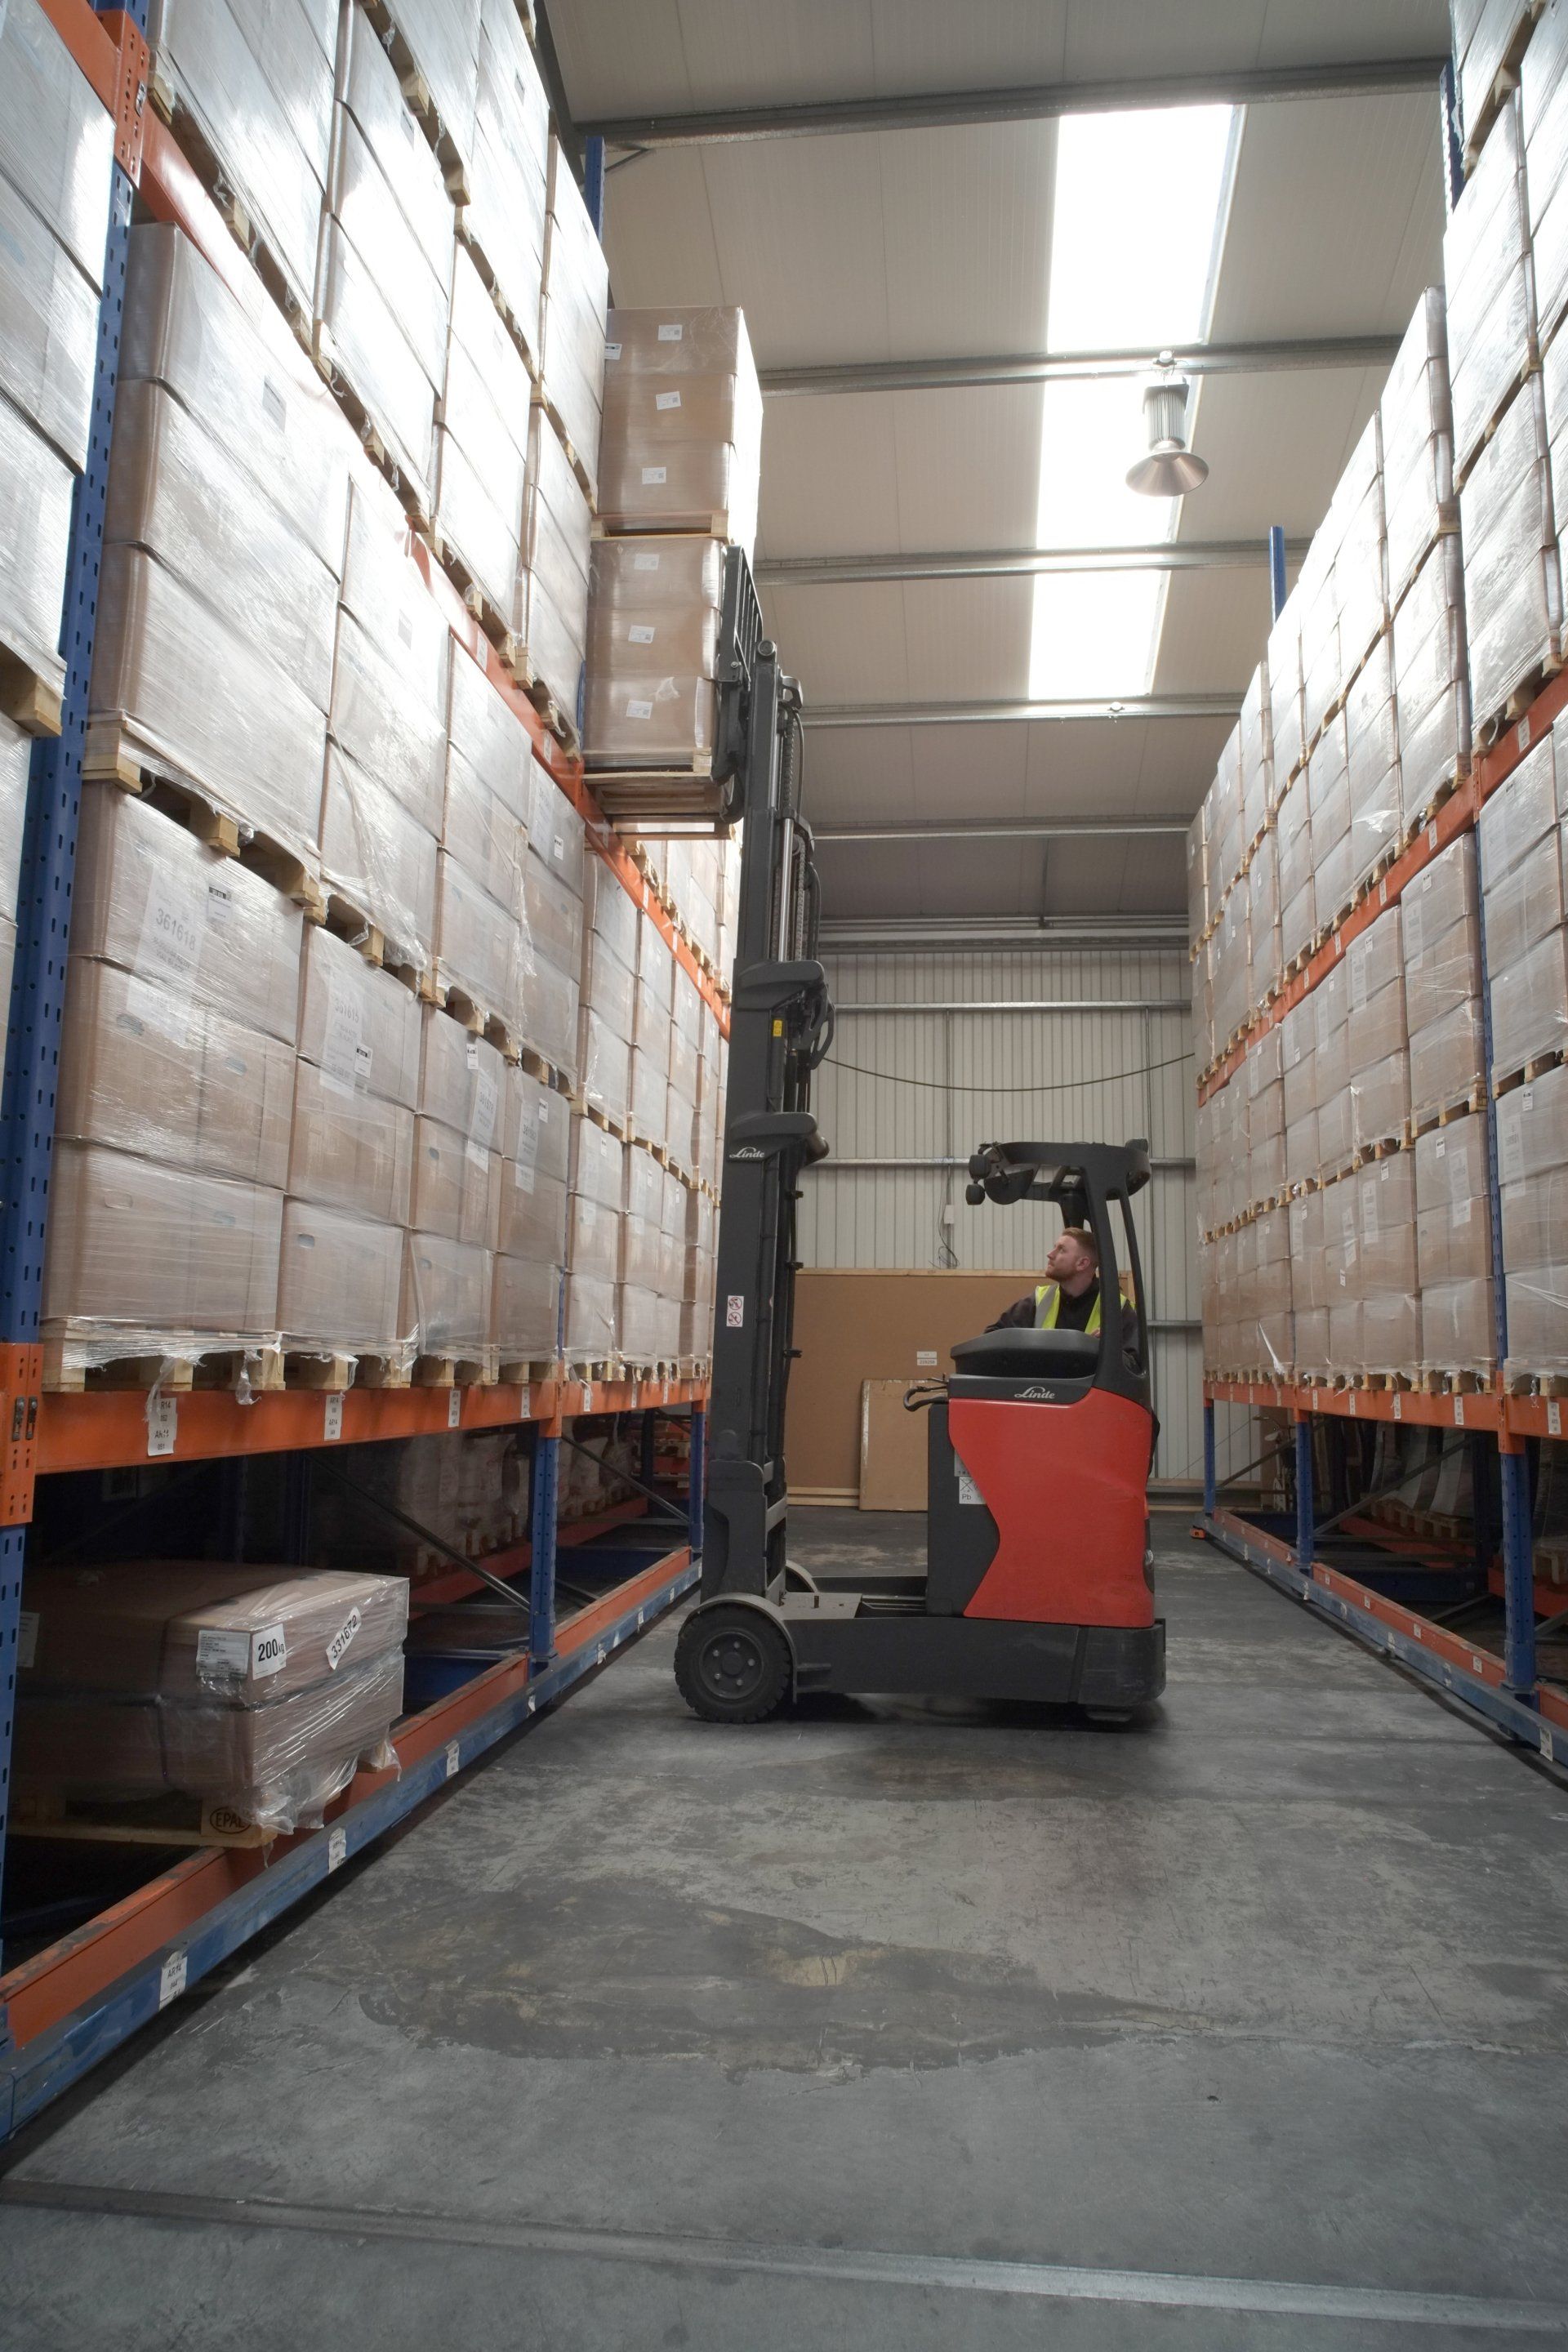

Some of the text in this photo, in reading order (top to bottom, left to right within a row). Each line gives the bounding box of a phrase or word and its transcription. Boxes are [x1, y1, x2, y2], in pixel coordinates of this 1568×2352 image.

[156, 907, 196, 951] 361618
[729, 1147, 764, 1159] Linde
[1014, 1386, 1055, 1399] Linde
[159, 1400, 171, 1410] R14
[331, 1615, 357, 1659] 331672
[216, 1811, 245, 1829] EPAL
